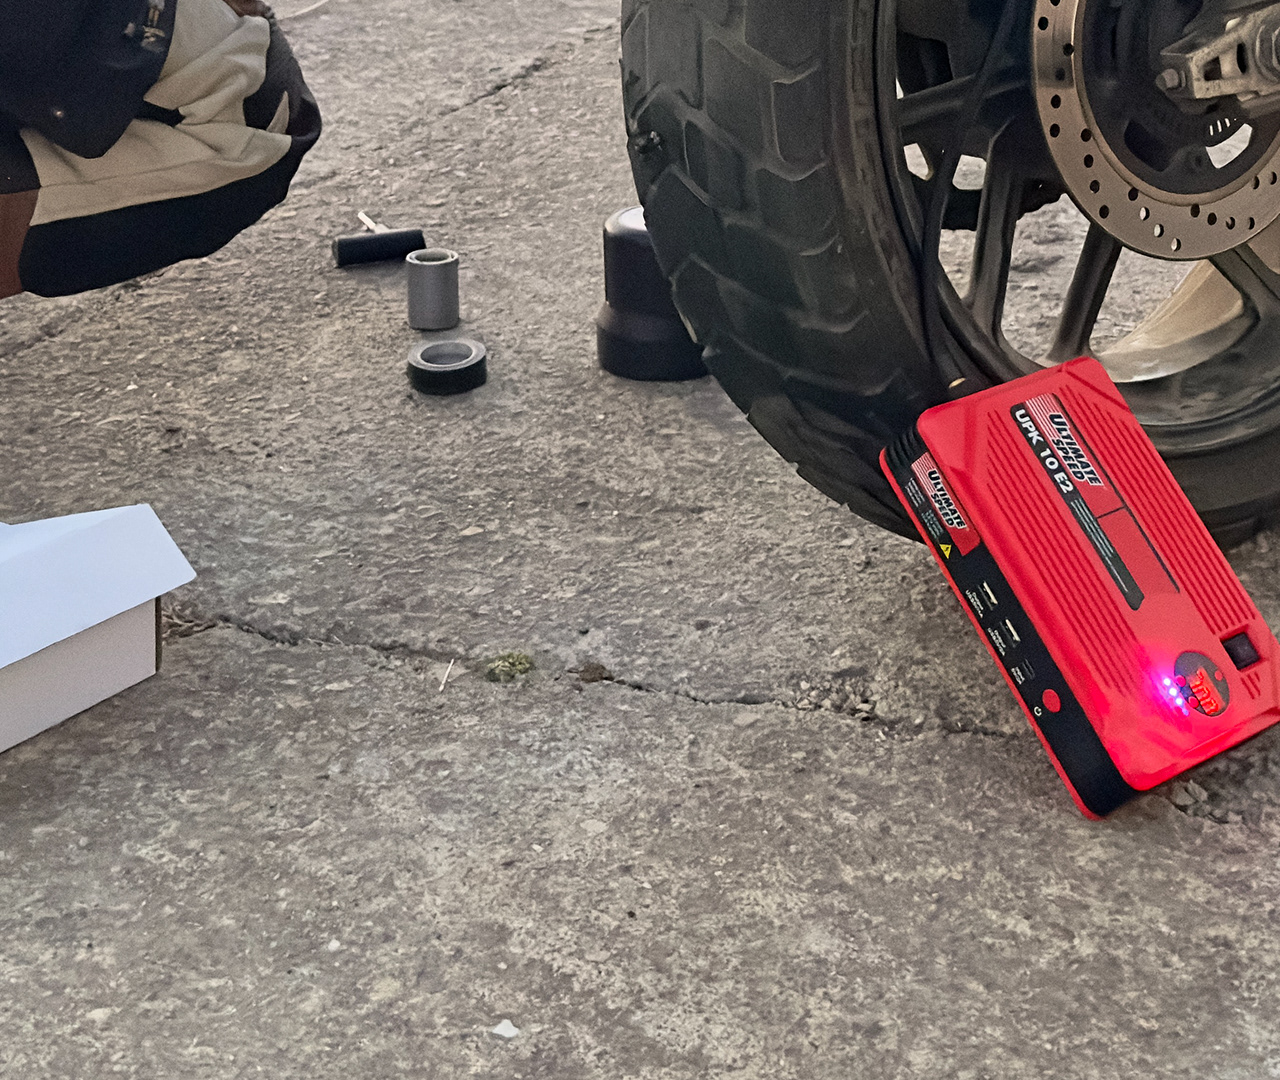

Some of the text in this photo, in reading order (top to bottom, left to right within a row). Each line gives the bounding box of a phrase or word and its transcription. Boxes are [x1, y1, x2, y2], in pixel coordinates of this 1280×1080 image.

[1015, 409, 1074, 494] UPK 10 E2
[1049, 412, 1103, 487] ULTIMATE
[1052, 438, 1087, 482] SPEED
[927, 469, 967, 528] ULTIMATE
[931, 493, 955, 527] SPEED
